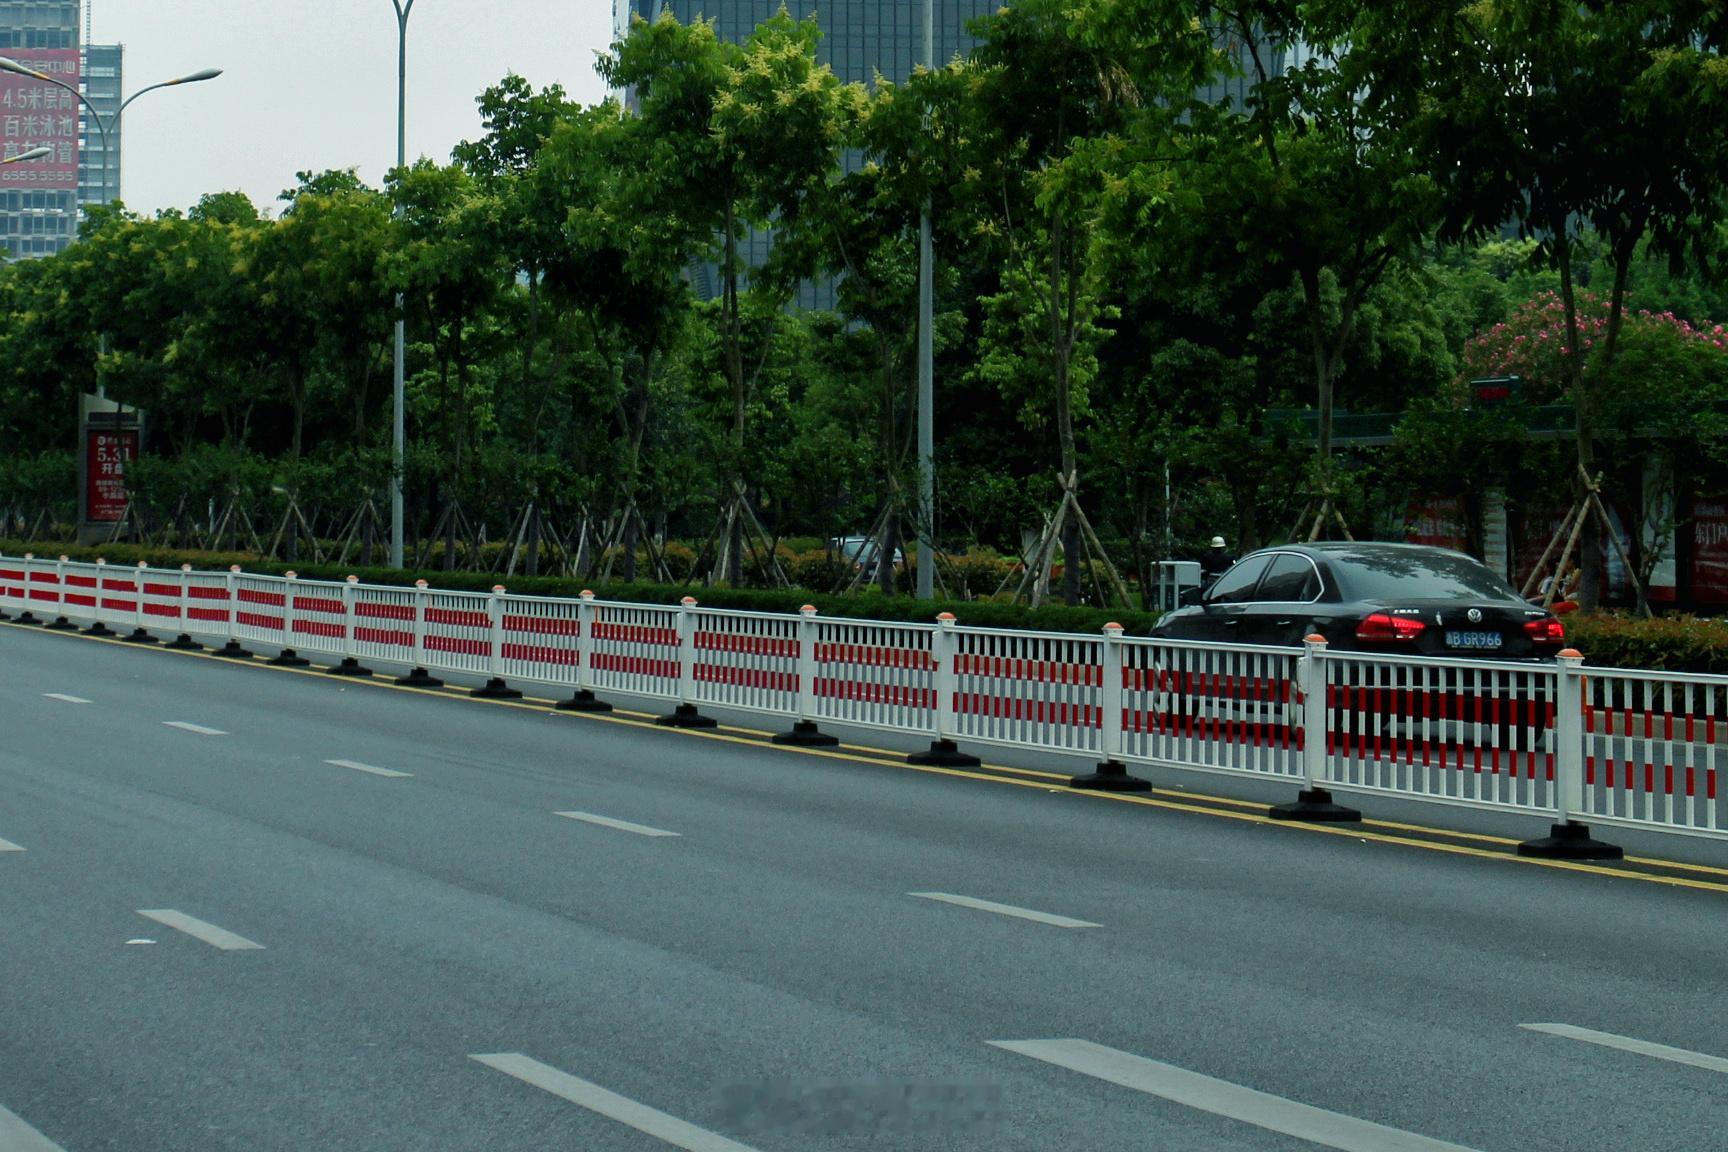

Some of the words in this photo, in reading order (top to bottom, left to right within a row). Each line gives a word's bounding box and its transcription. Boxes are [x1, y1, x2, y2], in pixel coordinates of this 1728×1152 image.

[3, 88, 73, 109] 4.5米层高
[4, 115, 73, 136] 百米泳池
